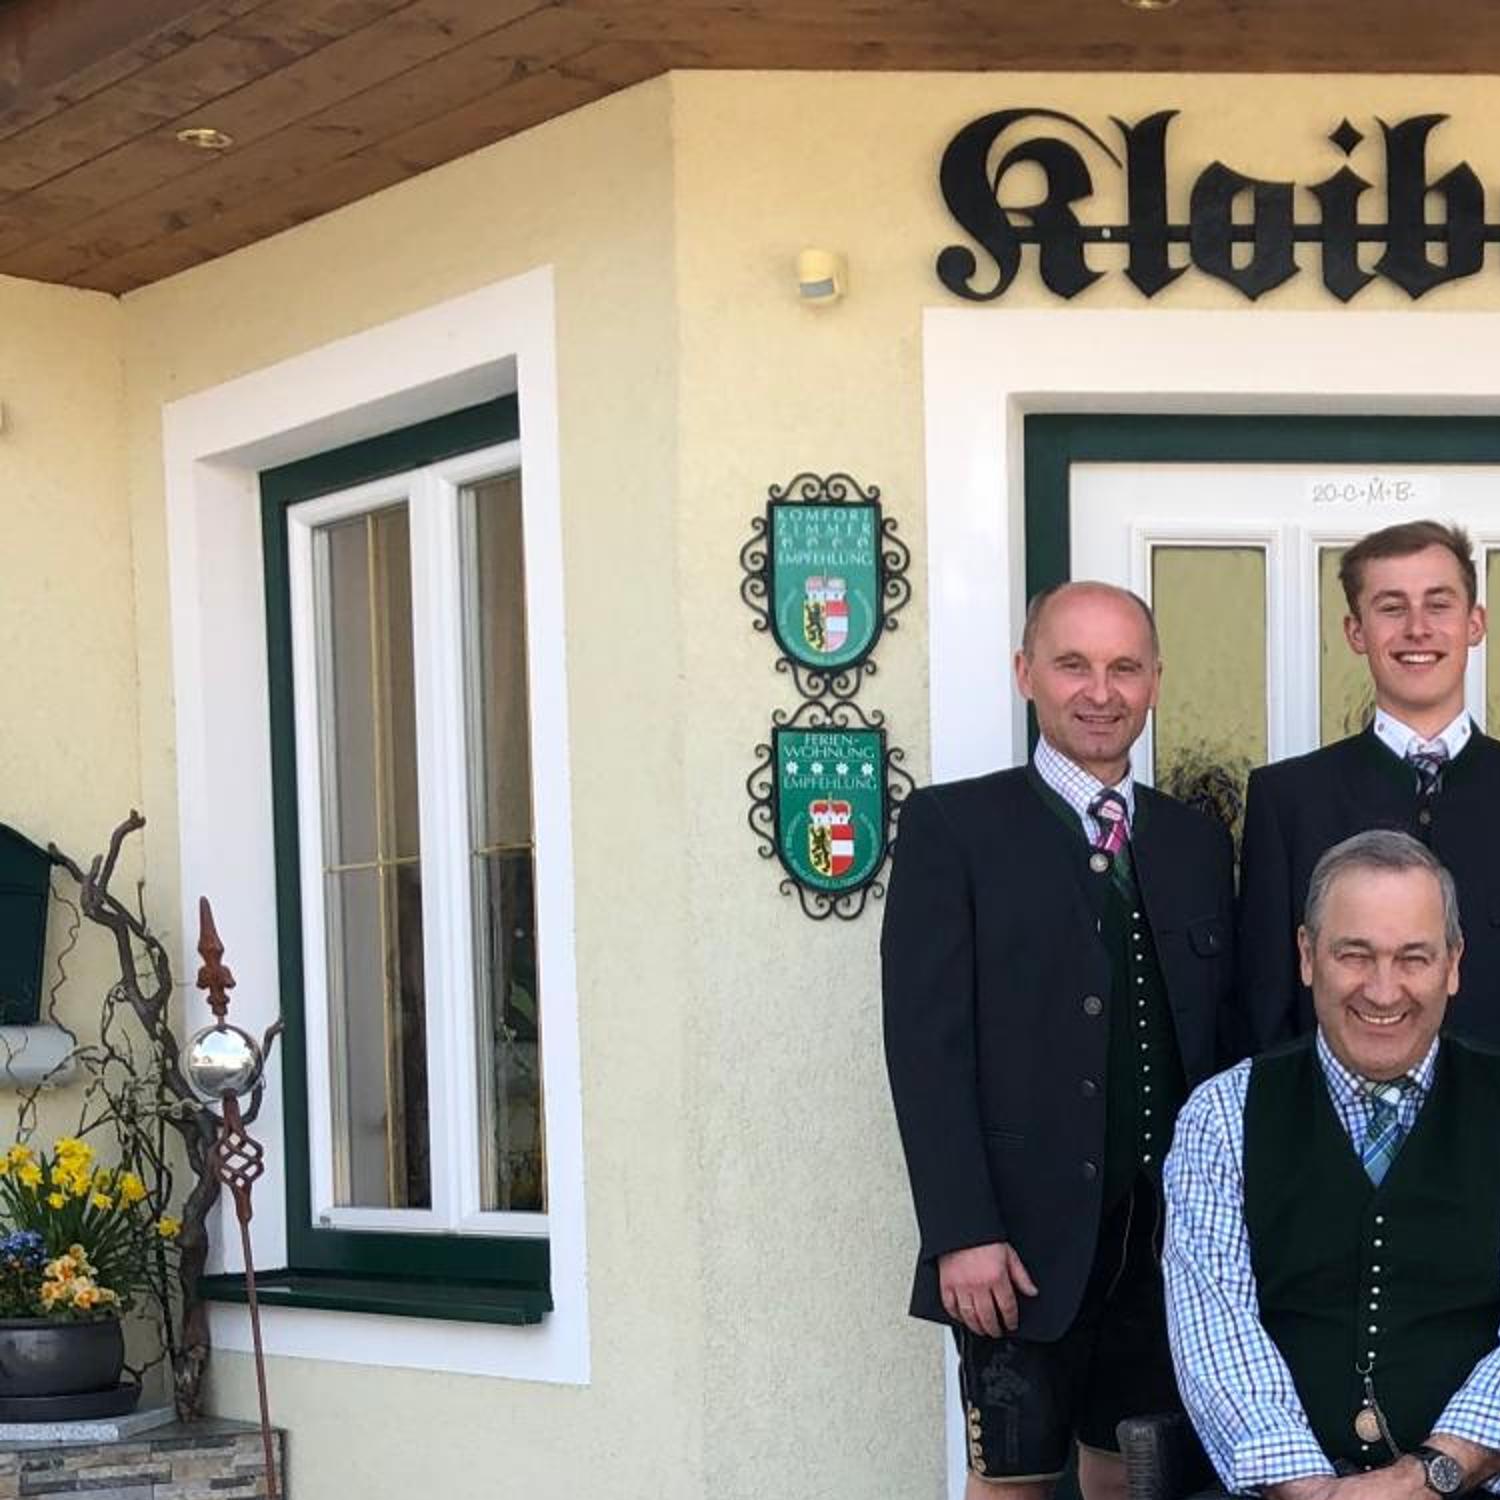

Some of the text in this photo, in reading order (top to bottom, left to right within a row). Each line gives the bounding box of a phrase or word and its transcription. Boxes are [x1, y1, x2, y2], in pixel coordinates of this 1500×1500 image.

[777, 508, 871, 521] KOMFORT
[778, 522, 872, 537] ZIMMER
[778, 551, 873, 565] EMPFEHLUNG
[805, 732, 860, 746] FERIEN-
[784, 745, 875, 759] WOHNUNG
[784, 776, 877, 790] EMPFEHLUNG
